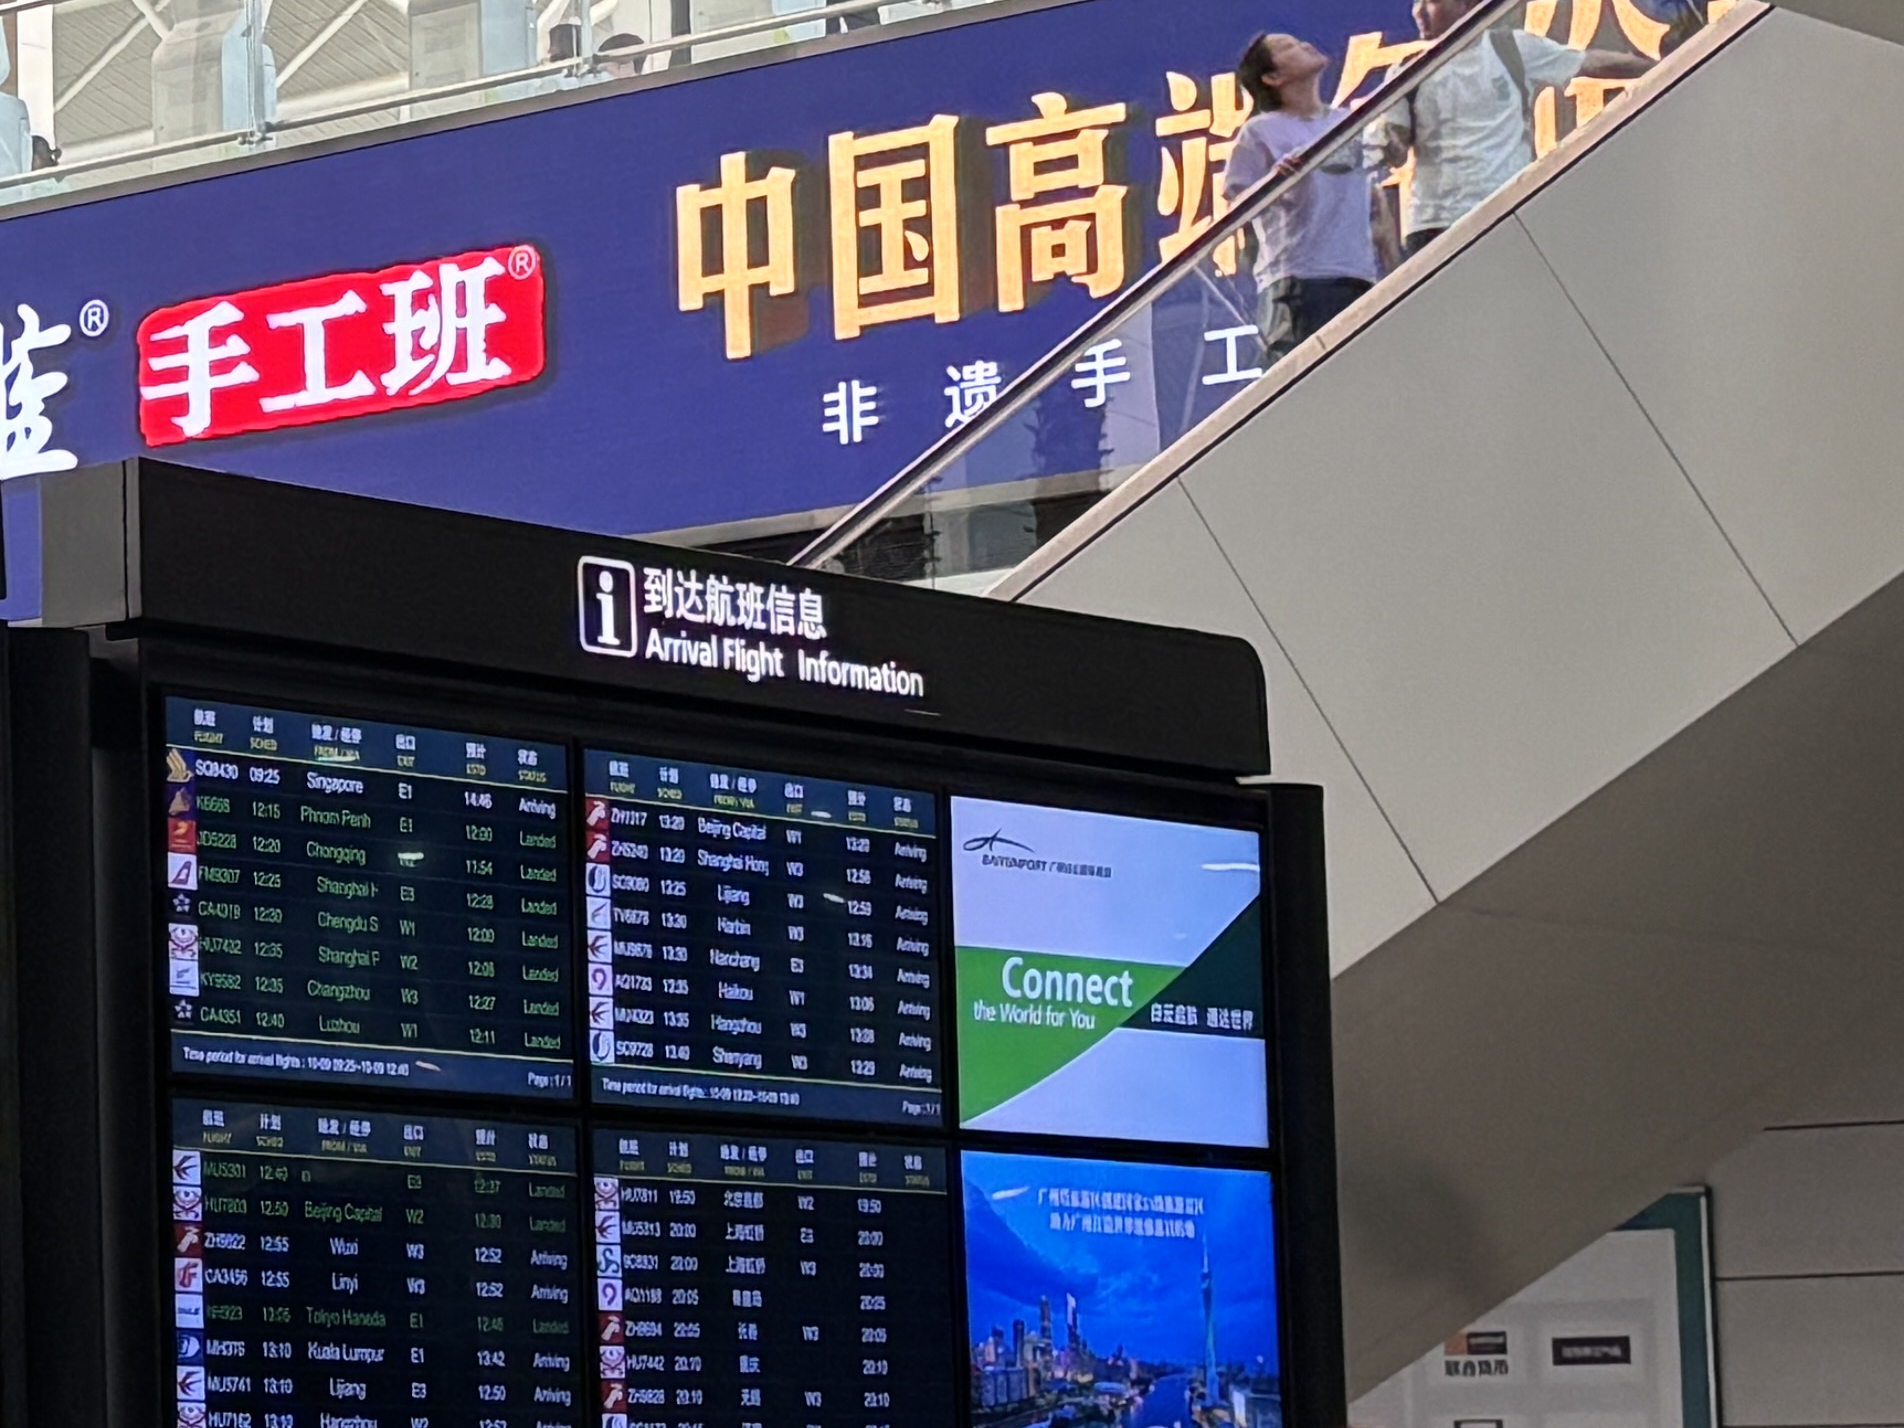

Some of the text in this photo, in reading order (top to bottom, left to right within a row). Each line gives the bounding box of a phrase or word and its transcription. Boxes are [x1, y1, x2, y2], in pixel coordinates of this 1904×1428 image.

[643, 566, 827, 640] 到达航班信息
[644, 627, 925, 698] Arrival Flight Information
[307, 771, 364, 794] Singapore
[307, 841, 366, 866] Chongqing
[1002, 956, 1133, 1008] Connect
[974, 1000, 1096, 1030] the World for You
